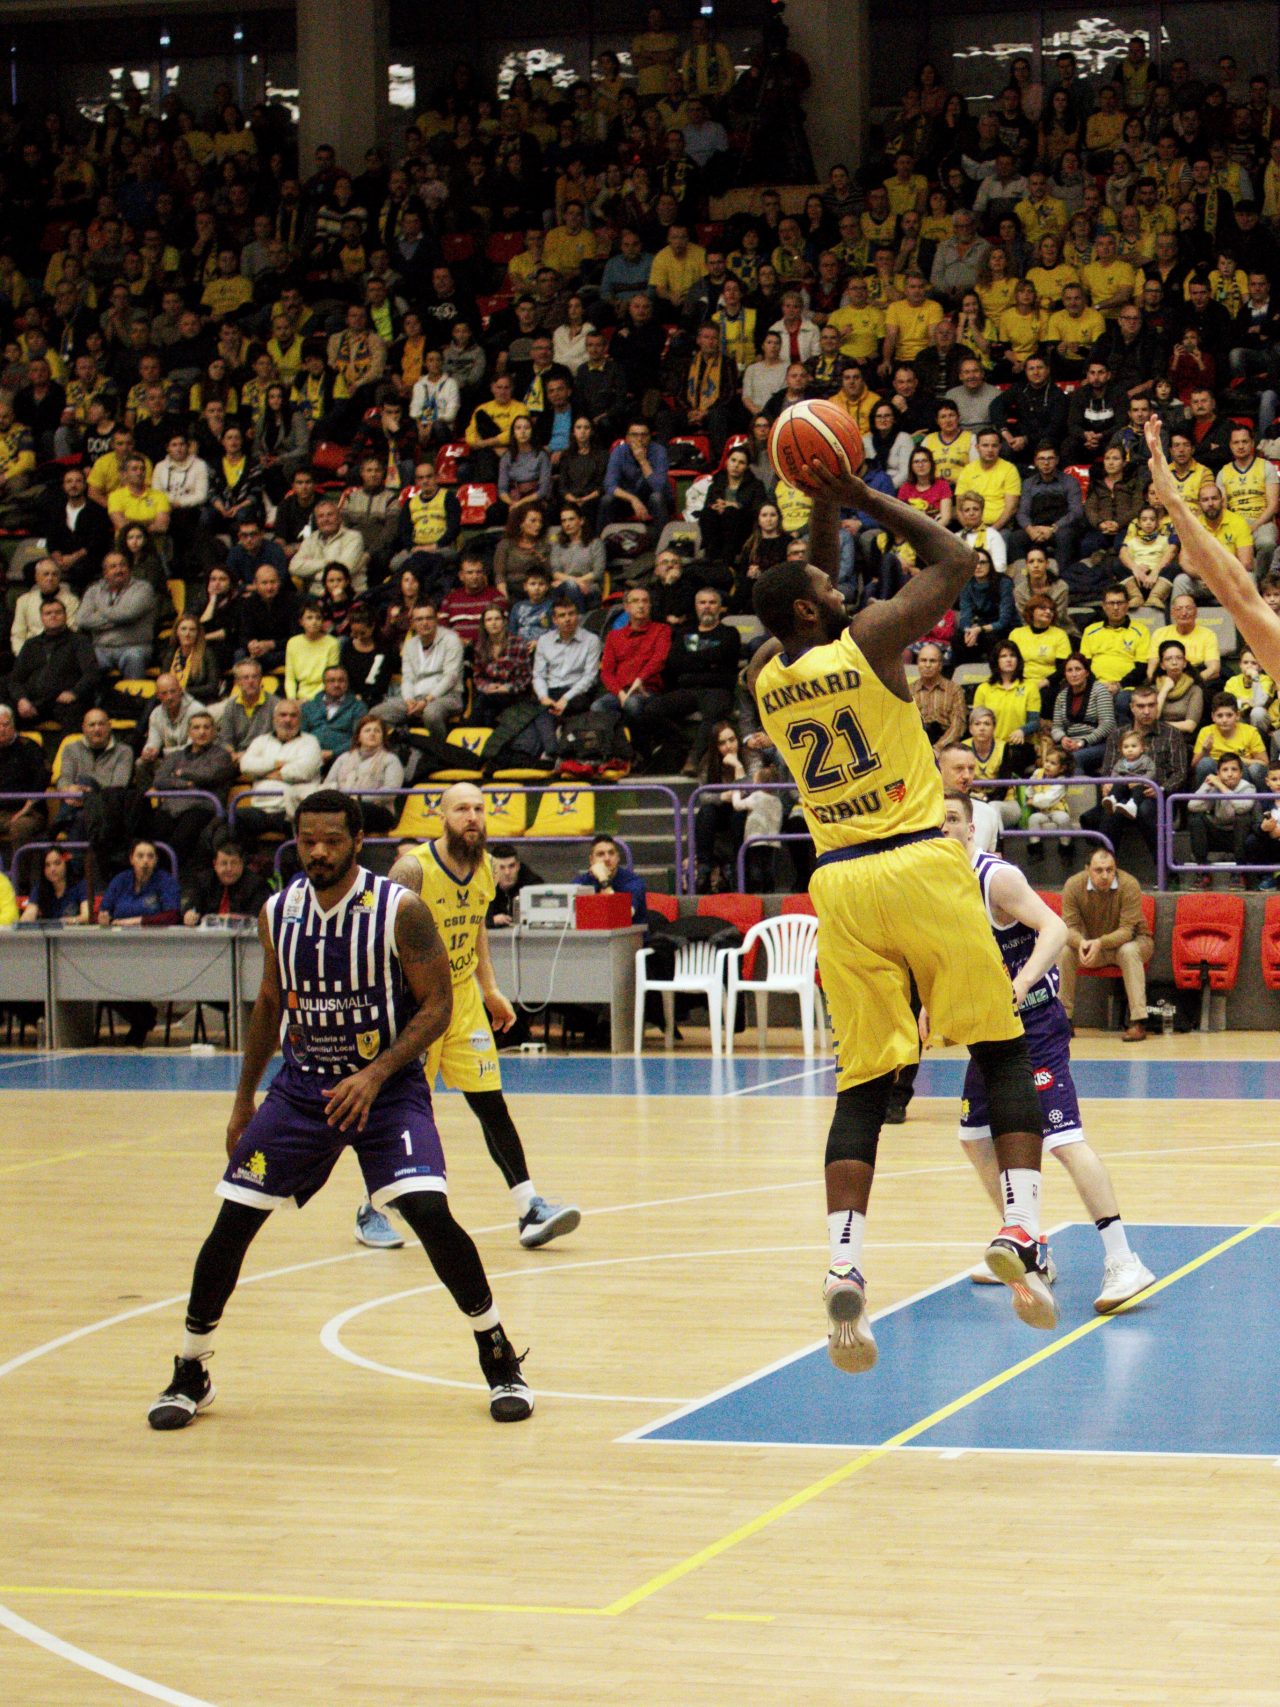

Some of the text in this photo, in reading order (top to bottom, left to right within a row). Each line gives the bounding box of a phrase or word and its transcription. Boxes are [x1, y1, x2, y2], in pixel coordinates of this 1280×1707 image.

[761, 670, 863, 715] KINNARD
[786, 705, 883, 794] 21
[443, 915, 466, 928] CSU
[314, 938, 327, 978] 1
[401, 1130, 413, 1156] 1
